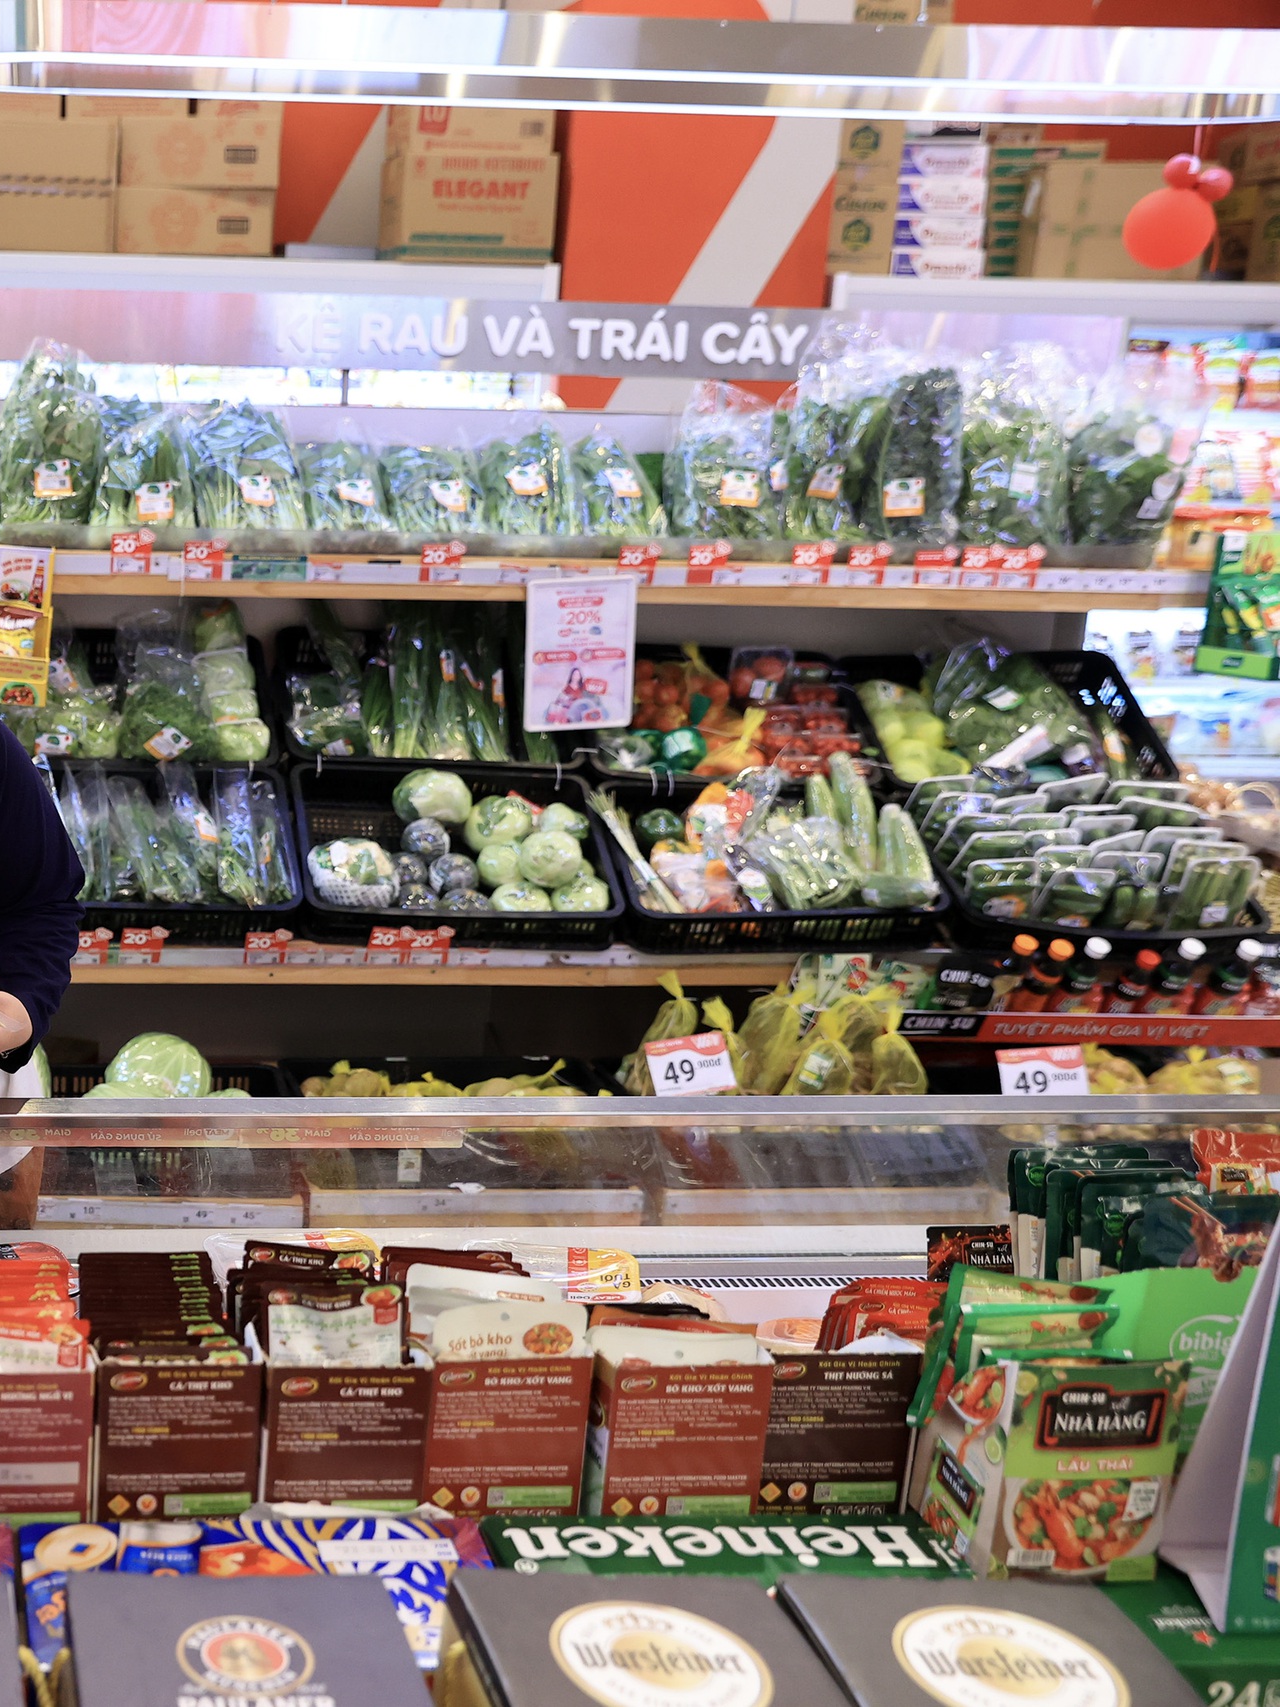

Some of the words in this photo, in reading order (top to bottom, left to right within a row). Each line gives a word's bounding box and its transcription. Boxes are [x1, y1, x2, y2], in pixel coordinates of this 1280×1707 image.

[433, 179, 530, 198] ELEGANT
[275, 306, 341, 366] KỆ
[359, 313, 468, 357] RAU
[481, 305, 556, 359] VÀ
[568, 309, 689, 362] TRÁI
[701, 312, 809, 366] CÂY
[566, 610, 601, 625] 20%
[940, 969, 991, 988] CHIN-SU
[904, 1016, 976, 1030] CHIN-SU
[994, 1023, 1050, 1038] TUYỆT
[1052, 1021, 1107, 1037] PHẨM
[1109, 1024, 1141, 1037] GIA
[1147, 1025, 1166, 1040] VỊ
[1169, 1024, 1210, 1040] VIỆT
[971, 1241, 994, 1249] CHIN-SU
[308, 1258, 324, 1266] KHO
[970, 1253, 991, 1265] NHÀ
[993, 1251, 1013, 1265] HÀN
[448, 1338, 467, 1352] Sốt
[470, 1335, 483, 1349] bò
[487, 1332, 513, 1346] kho
[1179, 1331, 1232, 1357] bibig
[484, 1375, 497, 1386] BÒ
[547, 1376, 572, 1385] VANG
[824, 1371, 844, 1382] THỊT
[845, 1370, 879, 1381] NƯỚNG
[381, 1386, 403, 1397] KHO
[665, 1383, 679, 1393] BÒ
[681, 1383, 727, 1393] KHO/XỐT
[728, 1384, 753, 1393] VANG
[1061, 1391, 1106, 1406] CHIN-SU
[1054, 1409, 1095, 1432] NHÀ
[1098, 1408, 1147, 1432] HÀNG
[1056, 1455, 1091, 1472] LẨU
[1097, 1456, 1134, 1471] THÁI
[502, 1525, 938, 1568] Heineken
[572, 1640, 747, 1676] Warsteiner
[915, 1647, 1099, 1683] Warsteiner
